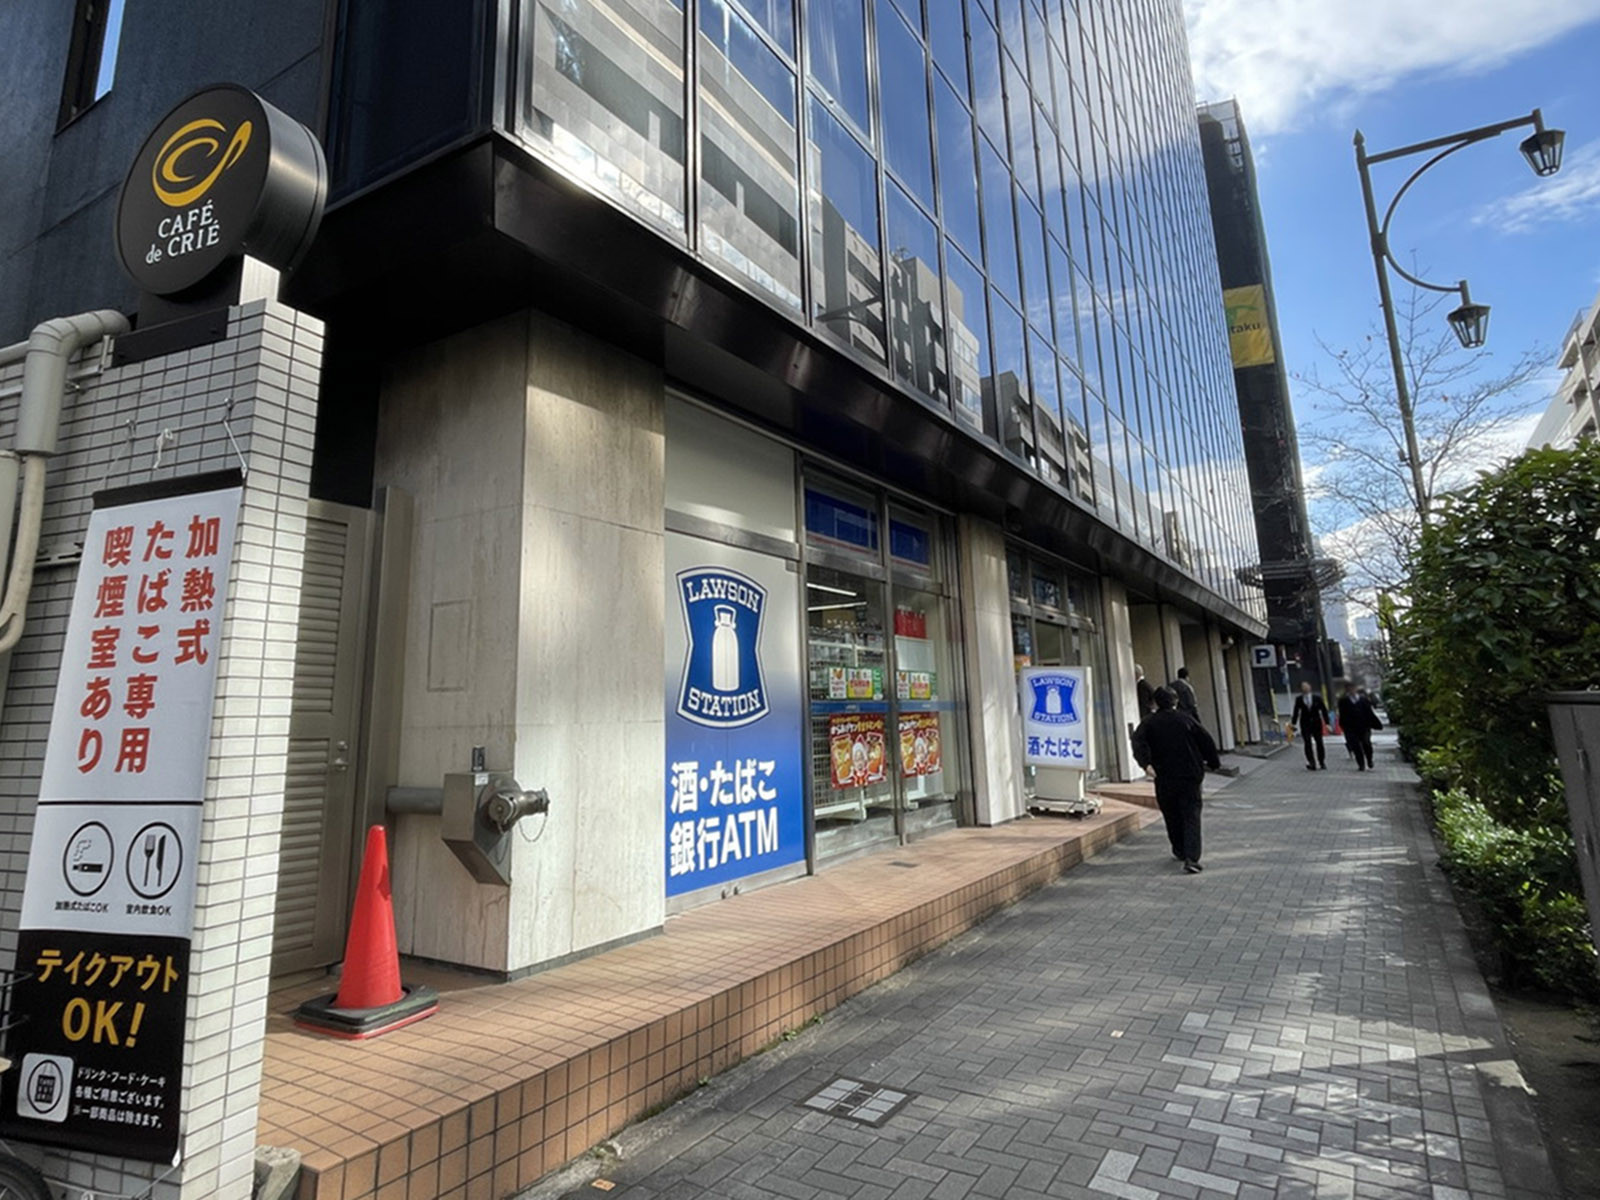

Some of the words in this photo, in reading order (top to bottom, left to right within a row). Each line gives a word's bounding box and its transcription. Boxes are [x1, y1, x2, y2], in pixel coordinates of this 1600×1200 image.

[158, 199, 214, 238] CAFÉ
[145, 243, 162, 264] de
[167, 219, 220, 257] CRIÉ
[1230, 322, 1260, 334] taku
[174, 515, 221, 665] 加熱式
[686, 578, 760, 612] LAWSON
[77, 526, 134, 774] 喫煙室あり
[114, 520, 175, 774] たばこ専用
[1255, 648, 1271, 664] P
[688, 687, 761, 717] STATION
[1032, 676, 1074, 688] LAWSON
[1033, 712, 1075, 723] STATION
[1028, 736, 1083, 758] 酒・たばこ
[671, 758, 777, 814] 酒・たばこ
[670, 806, 778, 877] 銀行ATM
[36, 950, 179, 992] テイクアウト
[62, 997, 146, 1048] OK!
